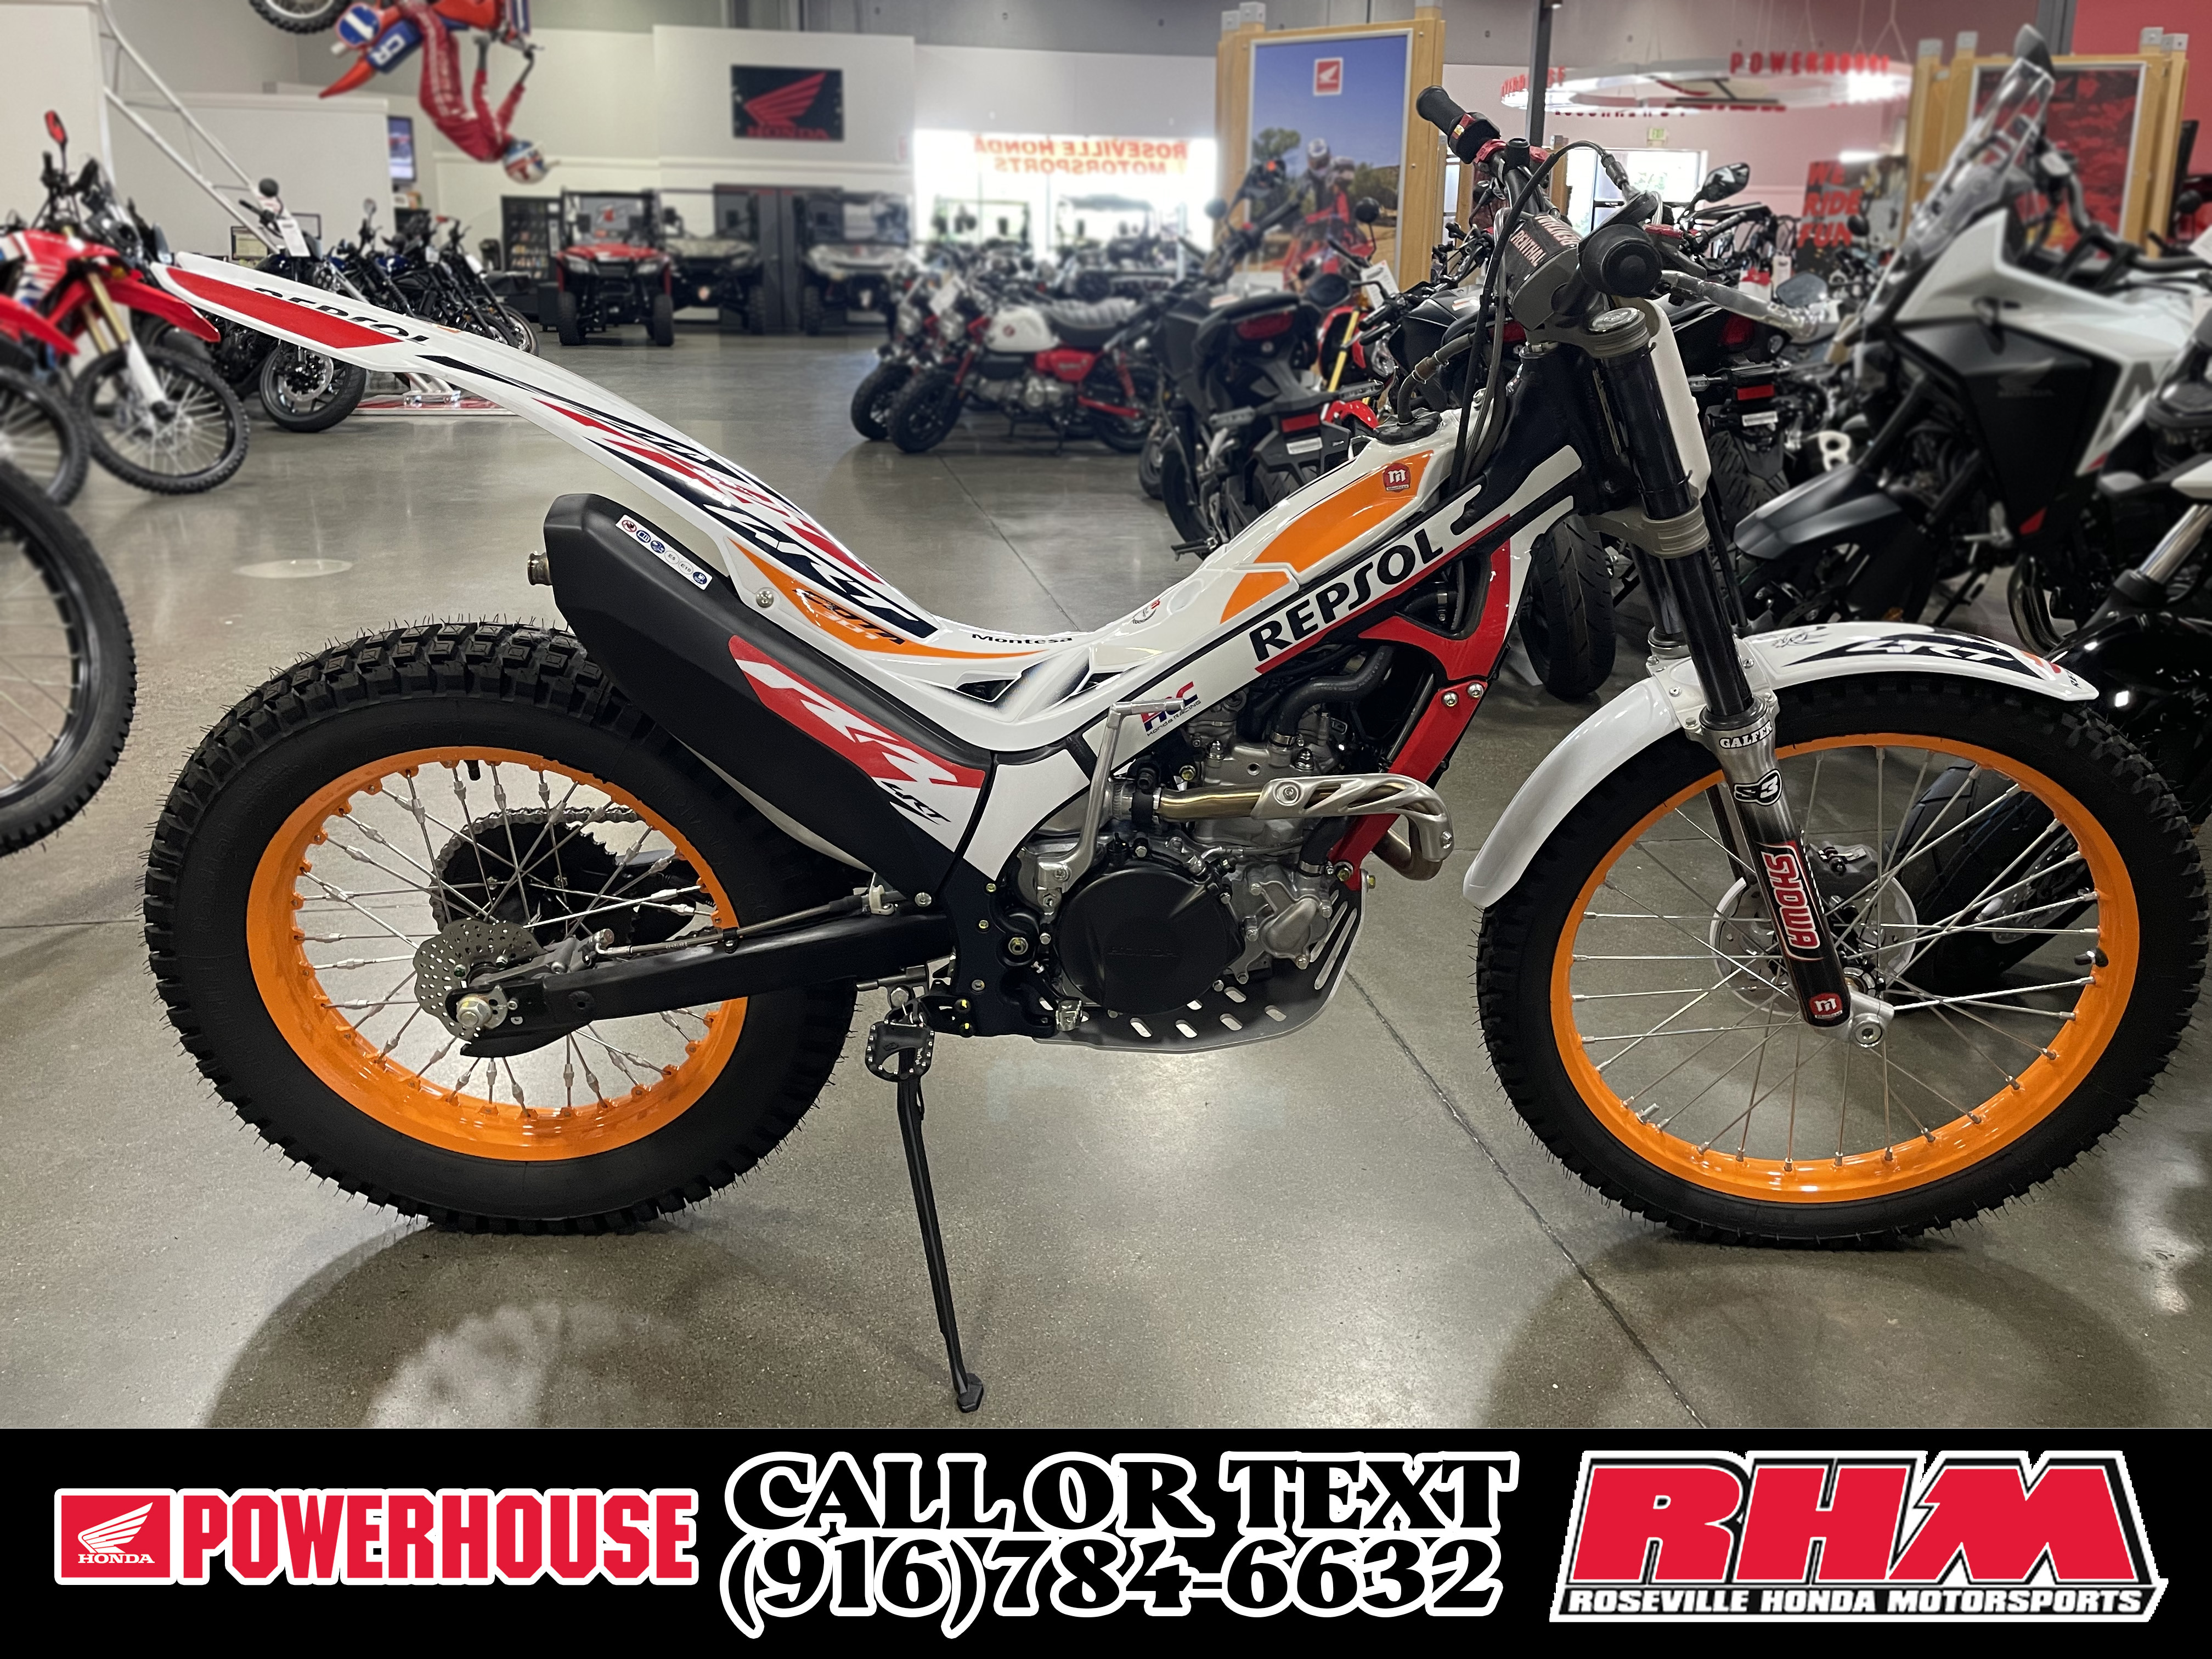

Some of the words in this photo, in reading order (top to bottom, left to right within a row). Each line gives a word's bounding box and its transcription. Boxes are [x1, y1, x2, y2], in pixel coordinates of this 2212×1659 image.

[369, 33, 406, 66] CR
[747, 126, 830, 140] HONDA
[1808, 162, 1846, 187] WE
[1802, 188, 1864, 218] RIDE
[1510, 229, 1547, 268] RENTHAL
[1797, 221, 1853, 249] FUN
[680, 563, 691, 572] E10
[1249, 528, 1443, 662] REPSOL
[972, 634, 1073, 644] Montesa
[1147, 719, 1173, 737] Honda
[1719, 720, 1773, 748] GALFER
[1762, 852, 1820, 948] SHOWA
